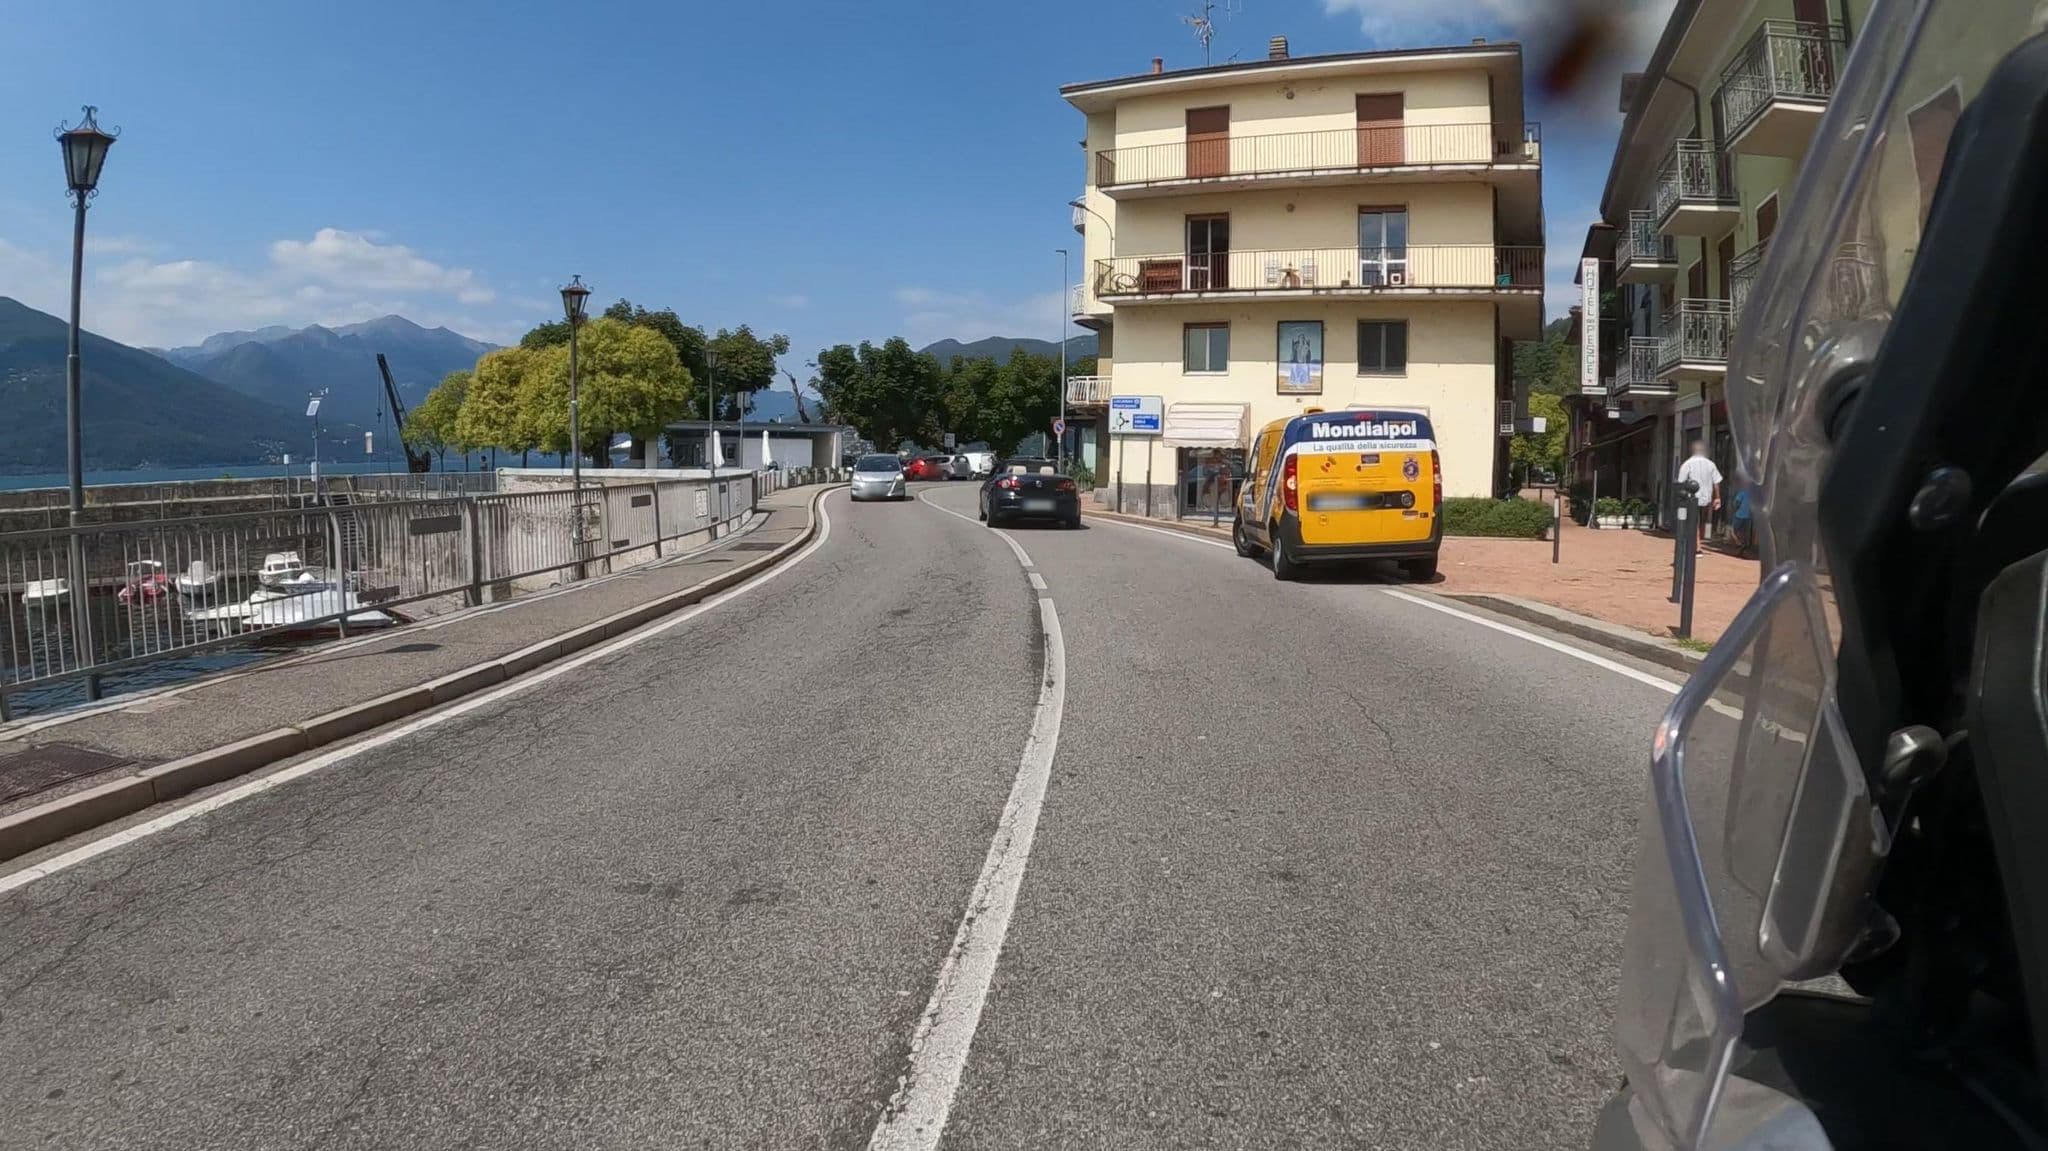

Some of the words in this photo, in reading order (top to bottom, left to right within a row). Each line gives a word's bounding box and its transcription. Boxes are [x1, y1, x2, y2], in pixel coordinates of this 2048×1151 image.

[1586, 268, 1595, 316] HOTEL
[1586, 325, 1595, 374] PESCE
[1312, 420, 1417, 439] Mondialpol
[1313, 443, 1324, 451] La
[1357, 442, 1377, 450] della
